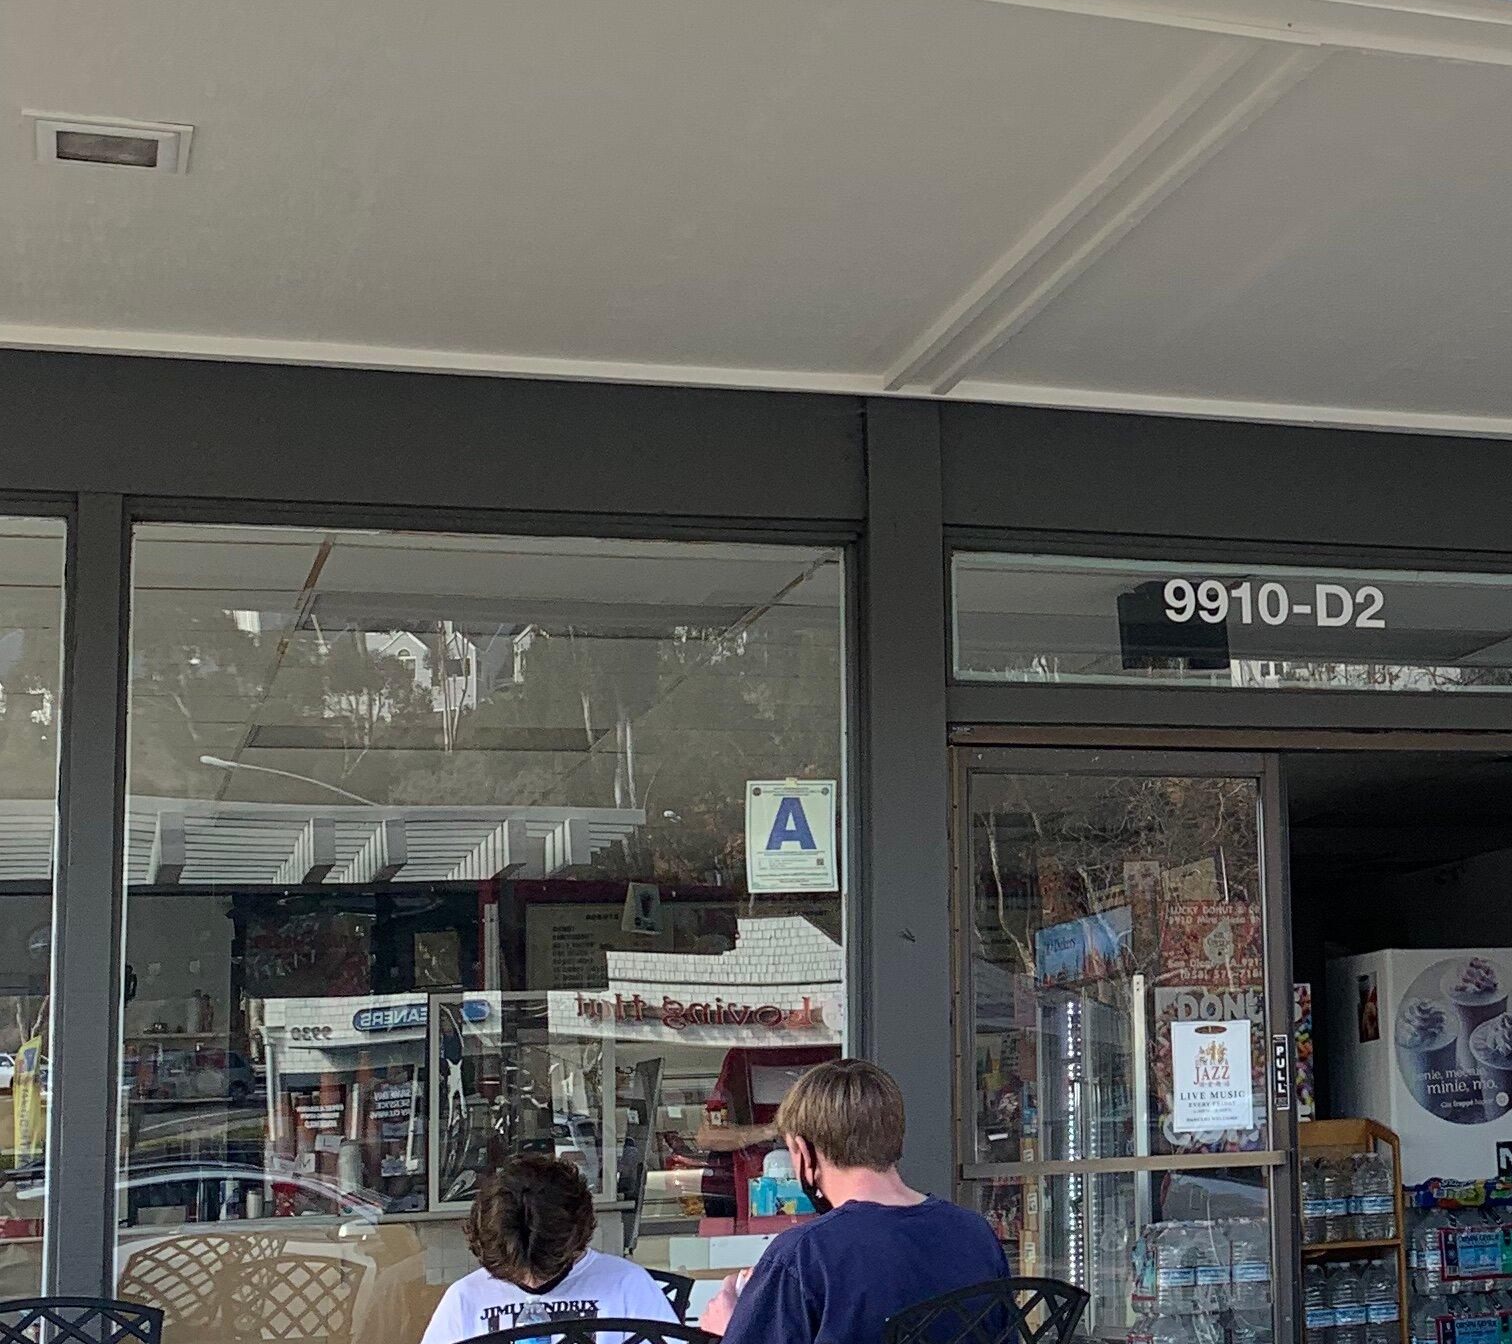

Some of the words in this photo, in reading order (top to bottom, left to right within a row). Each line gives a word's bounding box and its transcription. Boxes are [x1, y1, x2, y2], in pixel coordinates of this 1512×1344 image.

[1163, 578, 1386, 629] 9910-D2
[766, 797, 817, 850] A
[1193, 1065, 1231, 1085] JAZZ
[1275, 1045, 1286, 1094] PULL
[1180, 1091, 1206, 1101] LIVE
[1210, 1090, 1246, 1099] MUSIC
